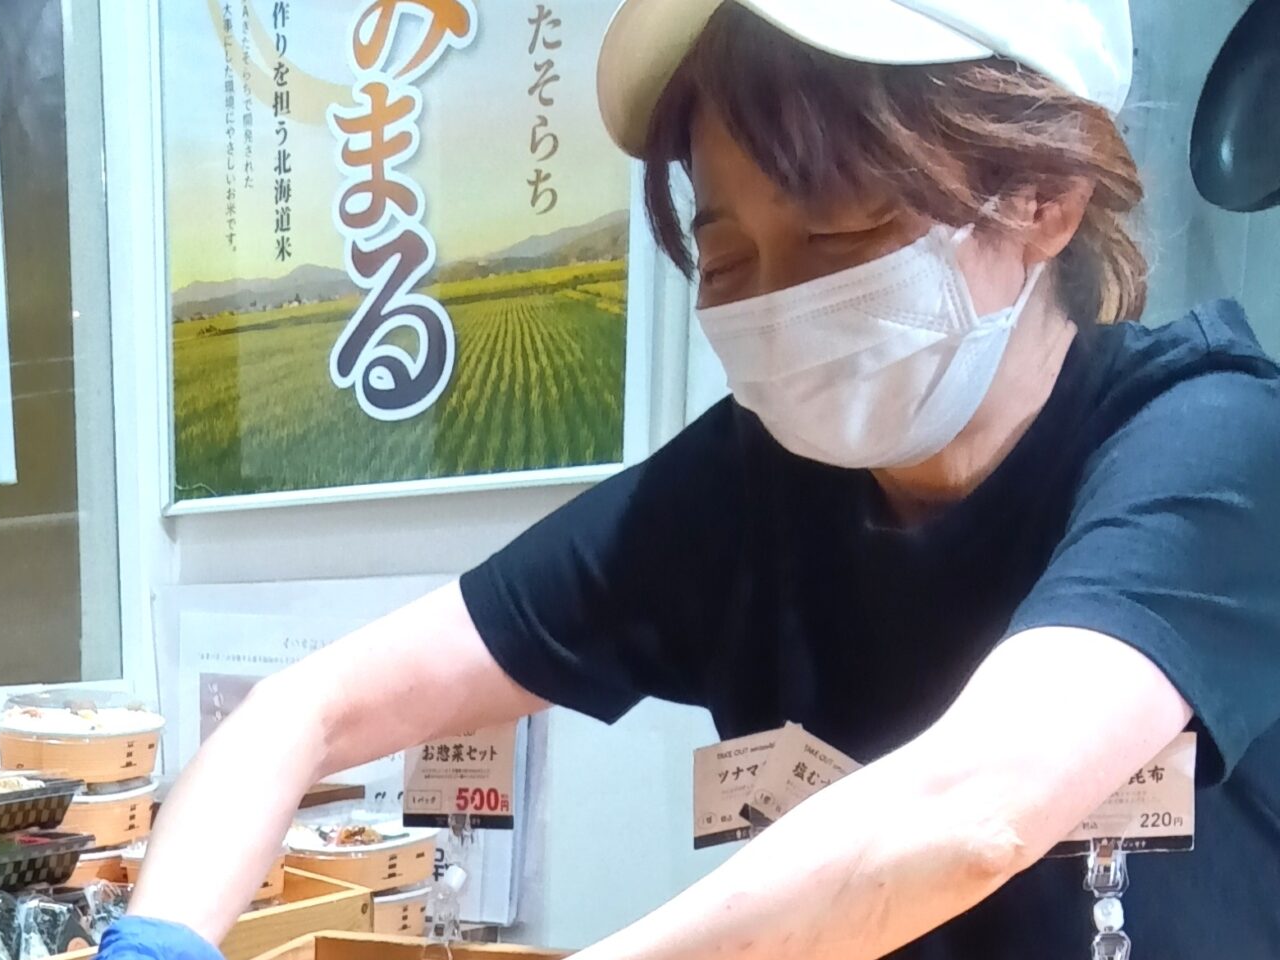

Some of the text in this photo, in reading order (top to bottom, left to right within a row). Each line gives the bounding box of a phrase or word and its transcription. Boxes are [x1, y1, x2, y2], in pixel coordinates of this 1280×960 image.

[526, 5, 563, 215] たそらち
[272, 0, 293, 262] 作りを担う北海道米
[422, 744, 499, 763] お惣菜セット
[718, 760, 767, 784] ツナマ
[1140, 811, 1183, 828] 220円
